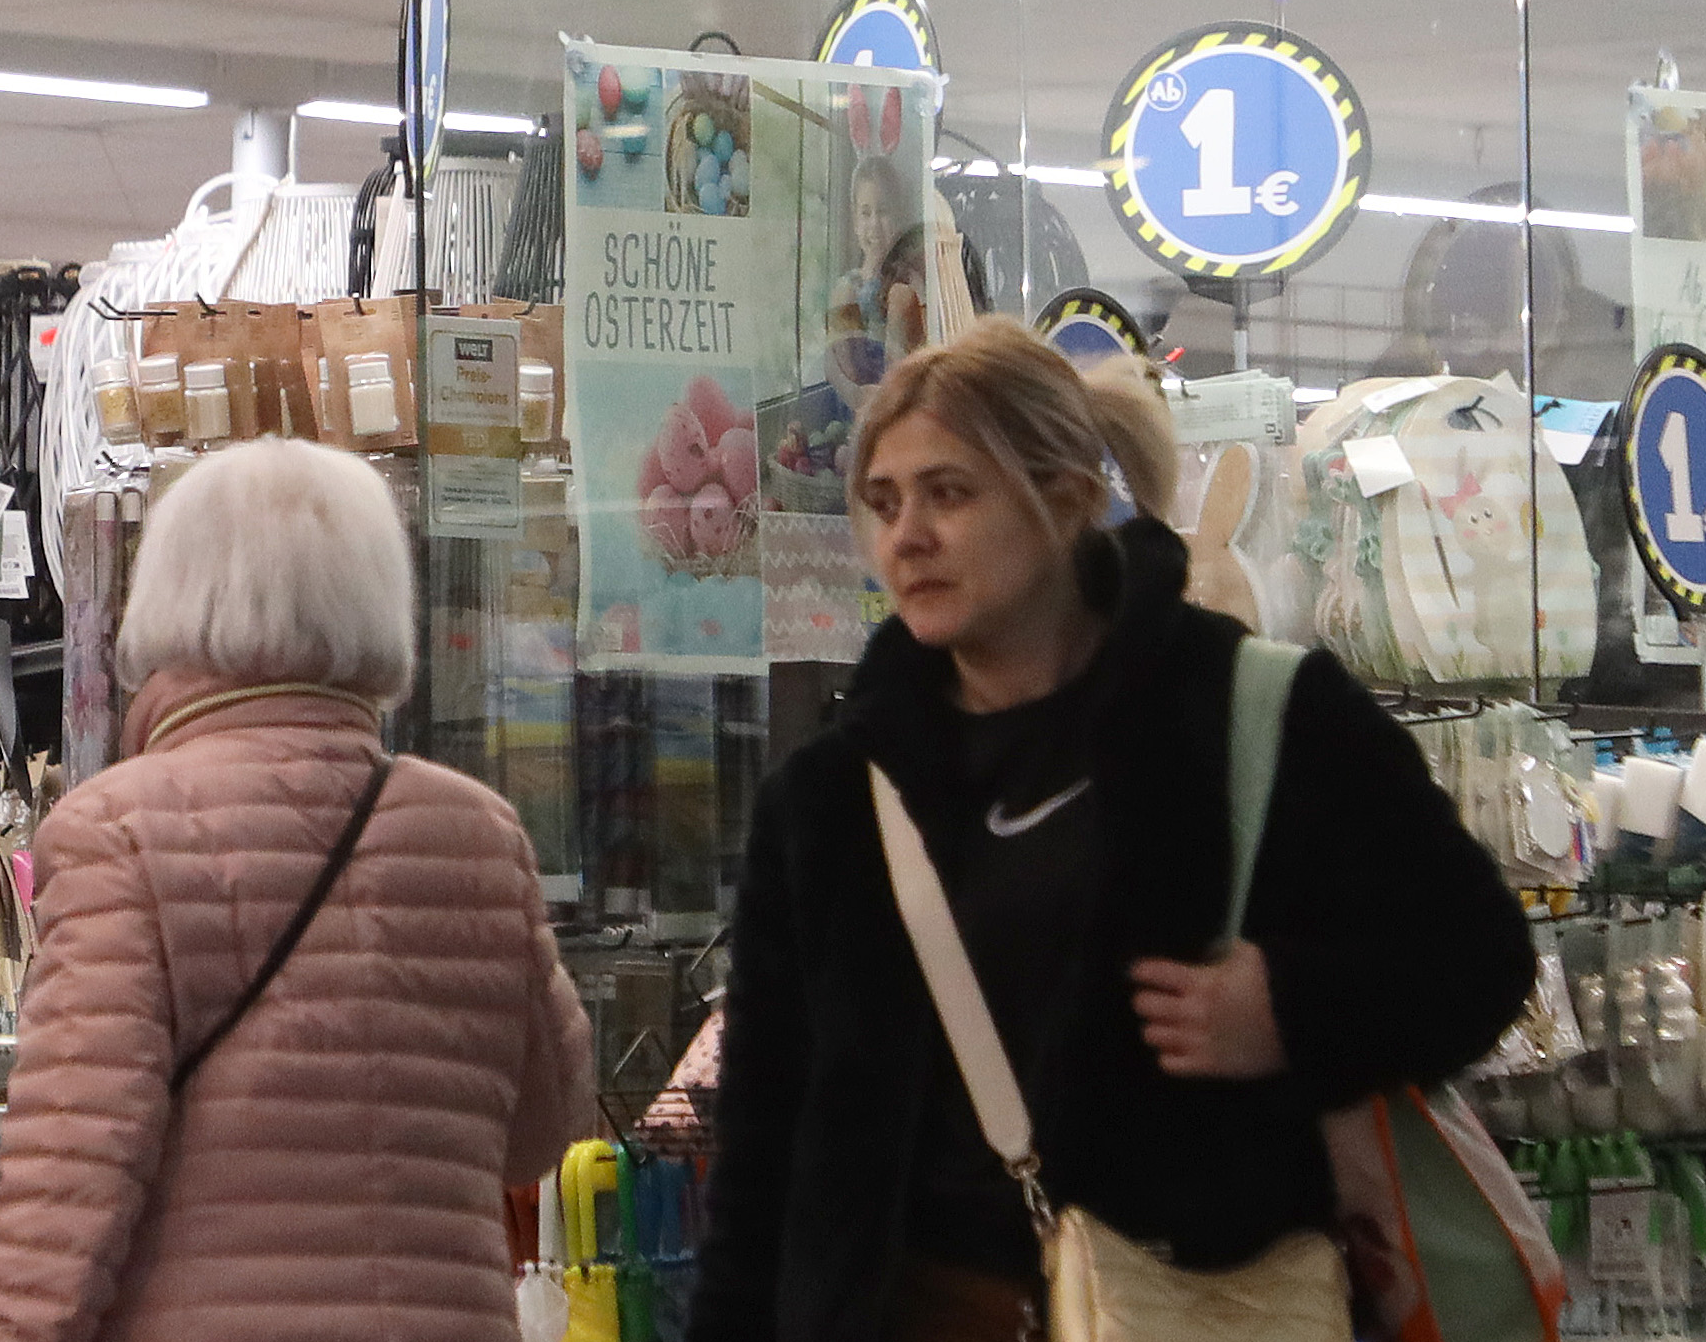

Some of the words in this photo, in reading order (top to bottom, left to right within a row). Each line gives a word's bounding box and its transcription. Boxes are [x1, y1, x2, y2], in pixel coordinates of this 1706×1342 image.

[1150, 75, 1182, 103] Ab
[1179, 88, 1300, 218] 1€
[603, 220, 718, 294] SCHÖNE
[583, 292, 736, 356] OSTERZEIT
[440, 386, 509, 407] Champions
[456, 365, 492, 383] Preis-
